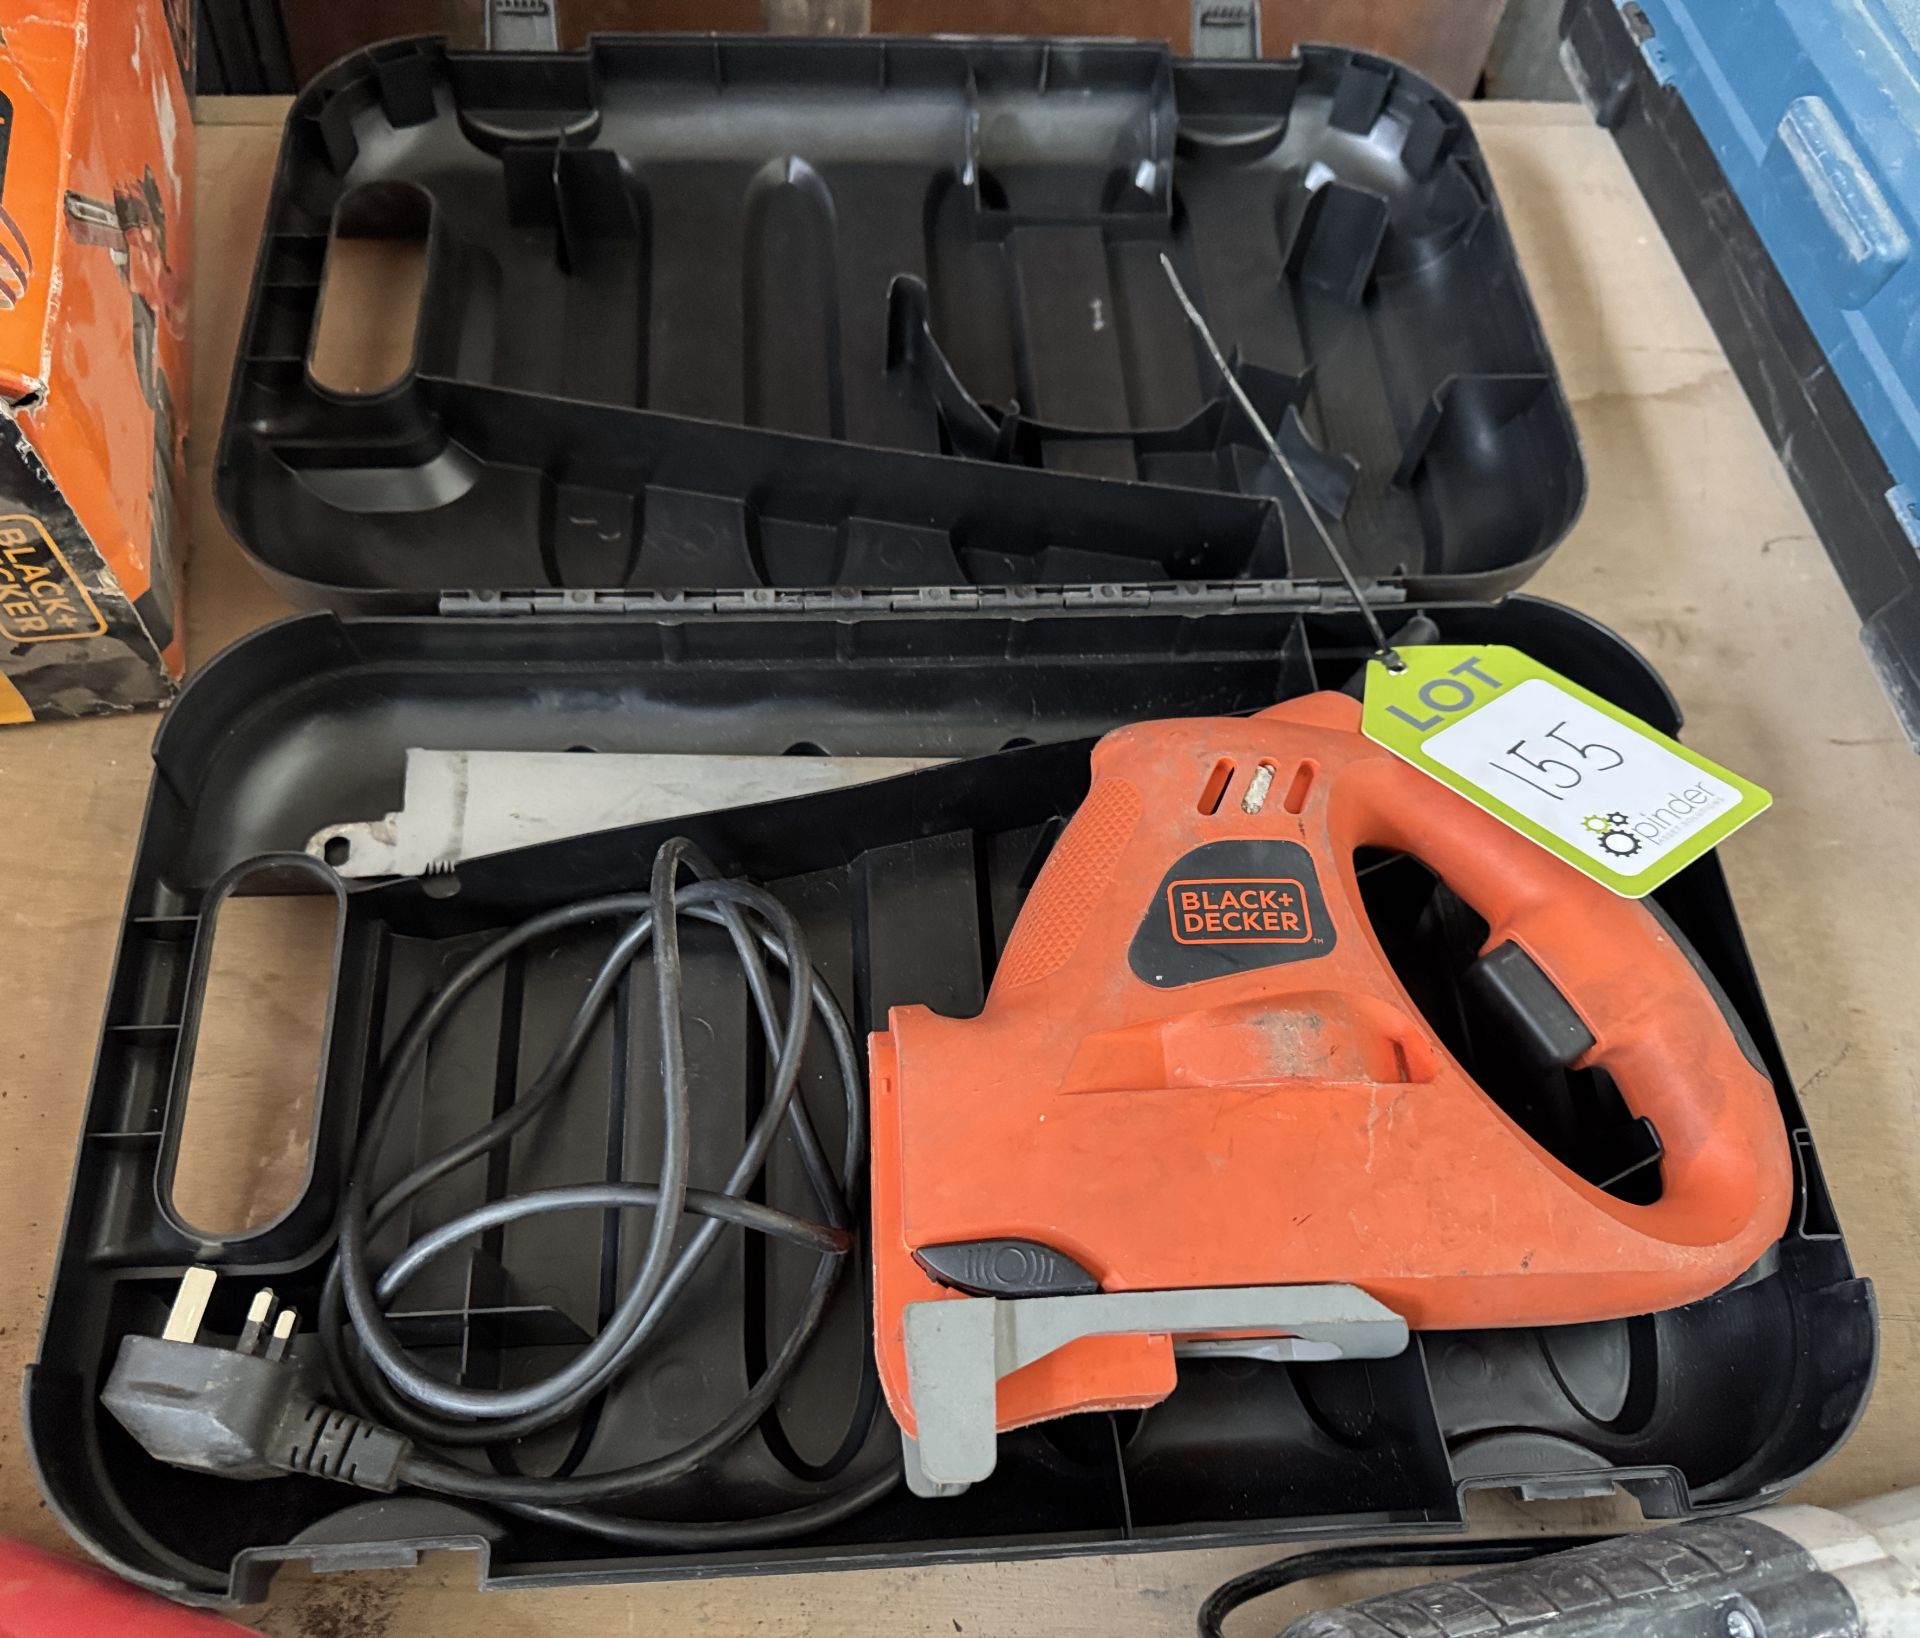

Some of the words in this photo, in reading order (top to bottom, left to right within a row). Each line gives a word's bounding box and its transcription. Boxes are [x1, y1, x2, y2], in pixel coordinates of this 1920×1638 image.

[1385, 656, 1503, 732] LOT
[1488, 721, 1624, 800] 155
[1631, 782, 1715, 846] pinder
[1180, 890, 1294, 910] BLACK+
[1183, 911, 1301, 932] DECKER
